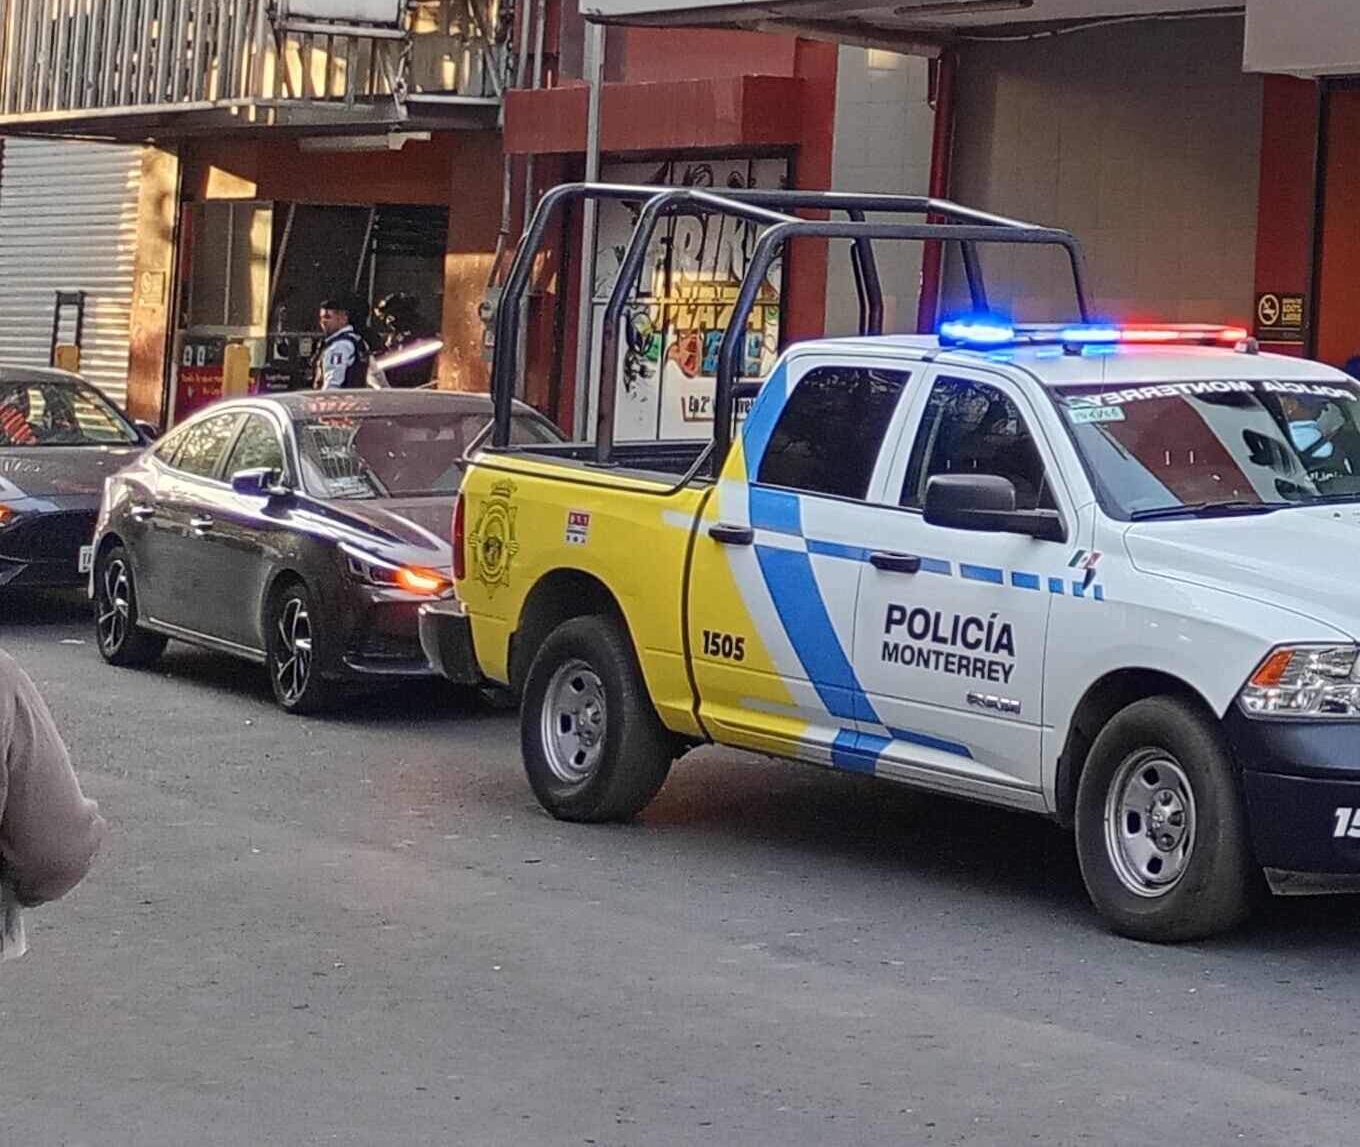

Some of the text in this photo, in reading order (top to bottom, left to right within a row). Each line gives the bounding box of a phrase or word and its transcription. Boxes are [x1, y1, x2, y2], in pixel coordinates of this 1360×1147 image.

[703, 630, 745, 661] 1505
[884, 603, 1015, 657] POLICÍA
[881, 641, 1014, 684] MONTERREY
